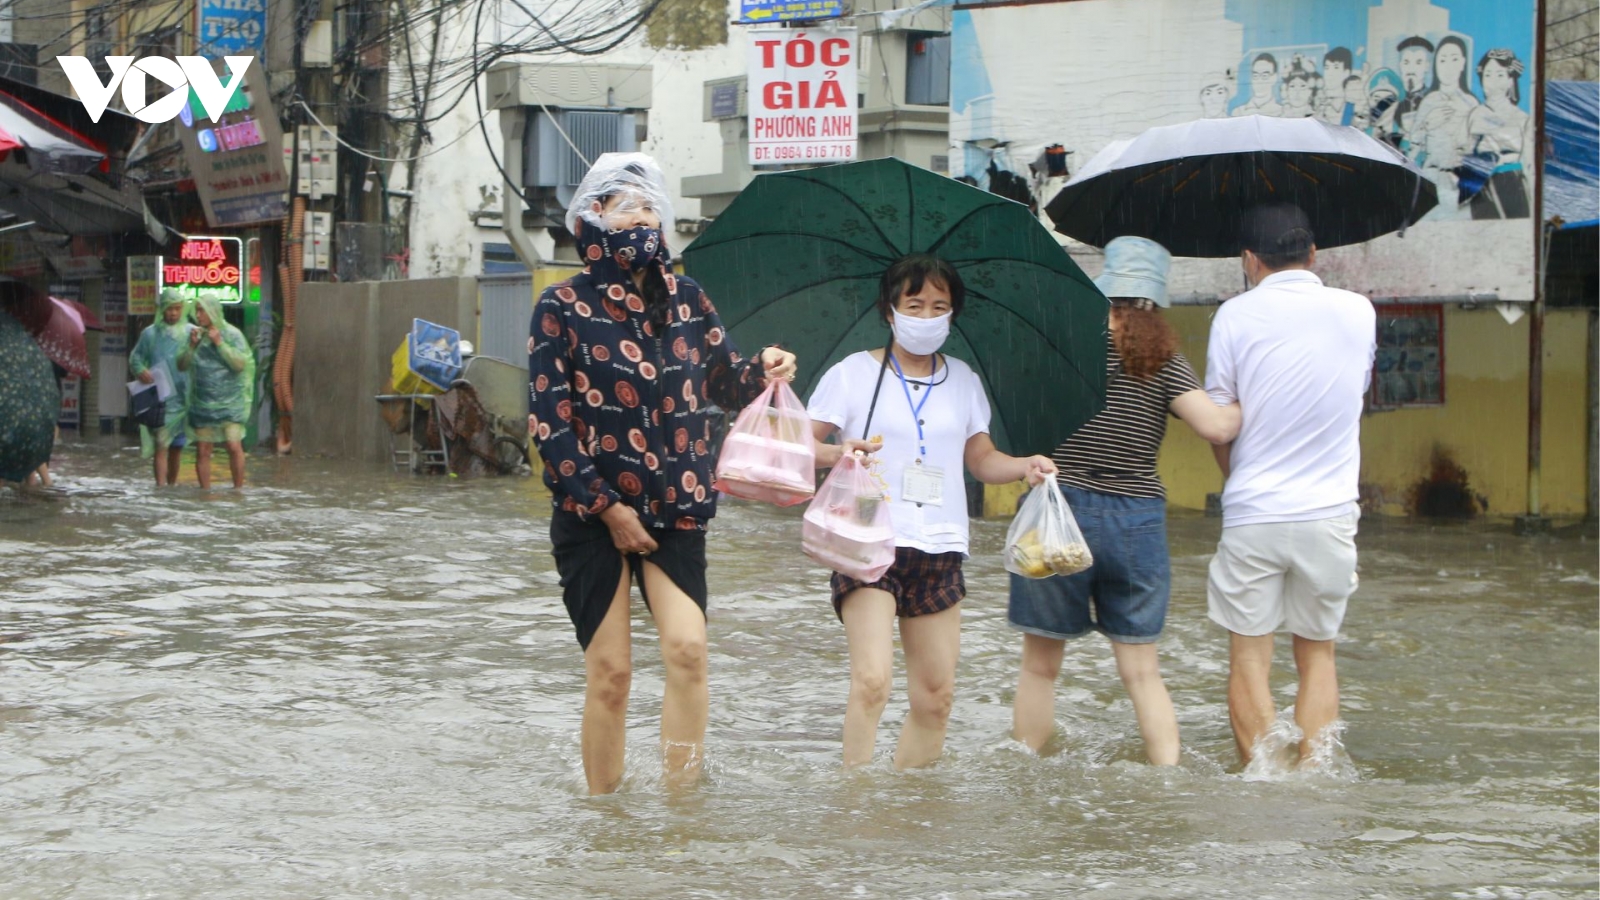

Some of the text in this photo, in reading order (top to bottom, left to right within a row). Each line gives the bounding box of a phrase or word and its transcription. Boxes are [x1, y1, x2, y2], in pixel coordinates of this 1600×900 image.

[204, 16, 261, 44] TRỌ
[755, 32, 850, 68] TÓC
[763, 70, 847, 110] GIẢ
[755, 115, 851, 138] PHƯƠNG ANH
[755, 145, 851, 160] ĐT: 0964 616 718
[181, 239, 226, 260] NHÀ
[163, 260, 239, 284] THUỐC
